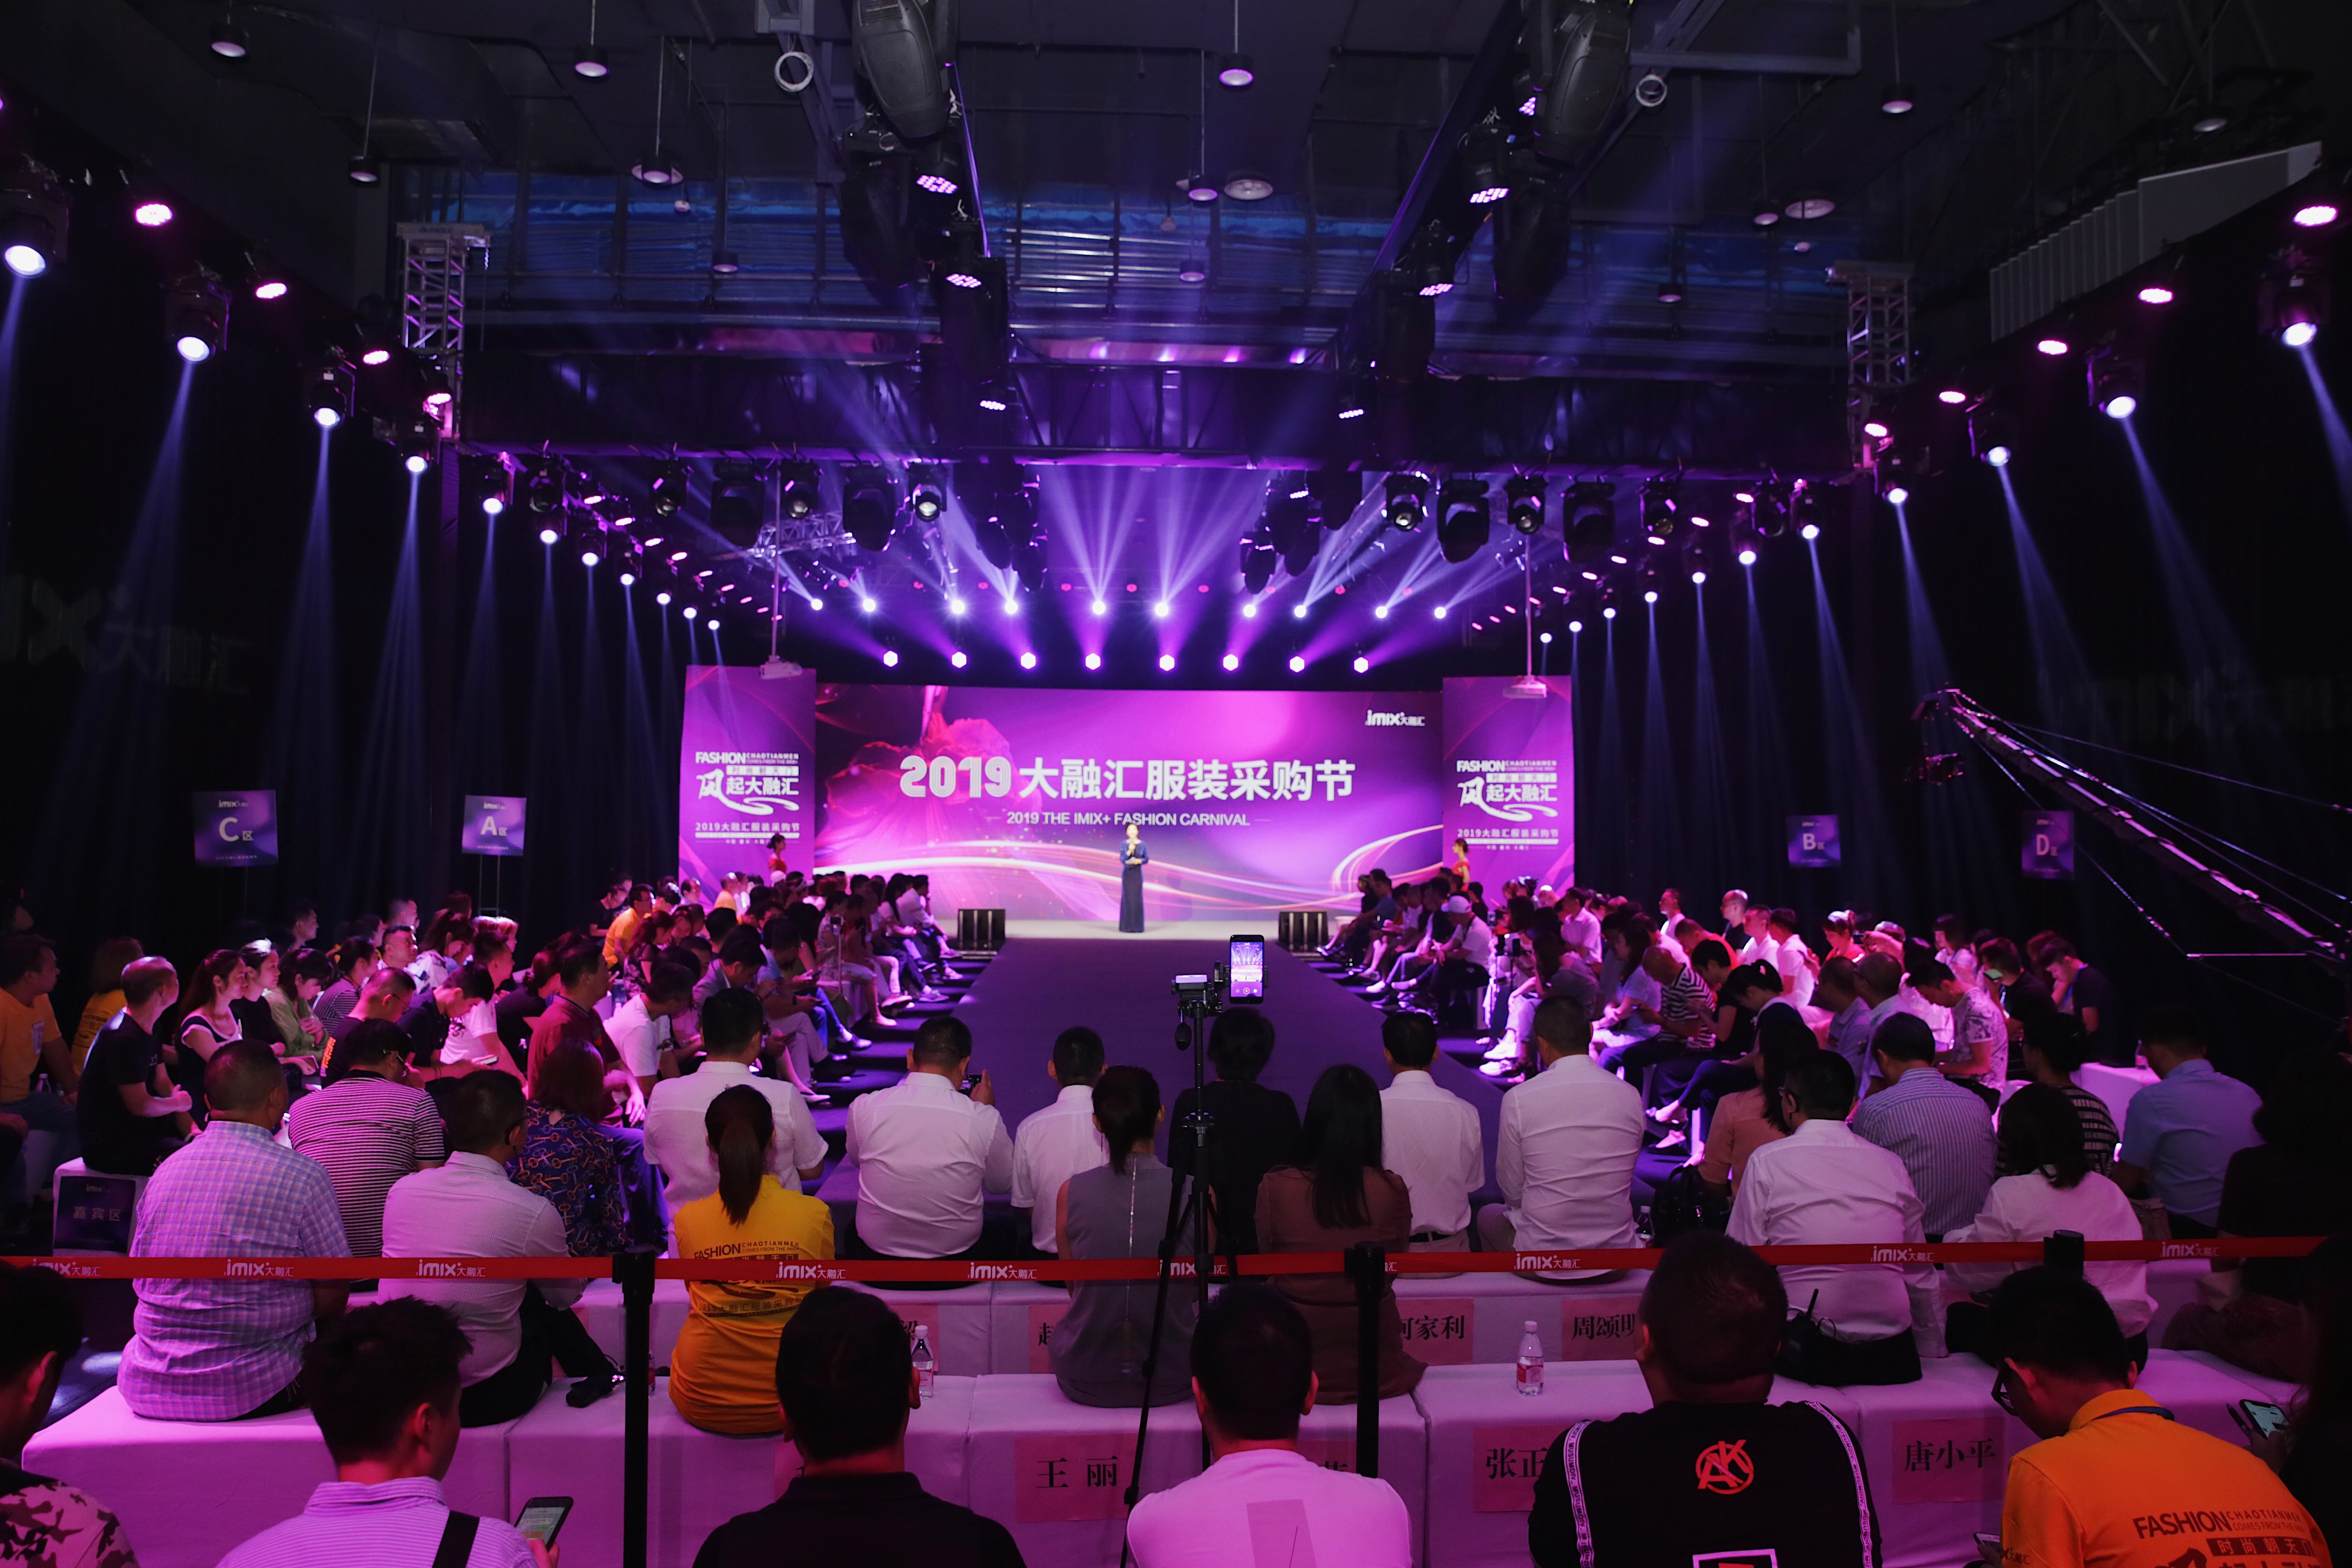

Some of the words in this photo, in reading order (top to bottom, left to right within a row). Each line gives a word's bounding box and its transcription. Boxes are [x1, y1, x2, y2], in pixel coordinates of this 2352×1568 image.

[695, 752, 746, 764] FASHION
[1457, 760, 1505, 772] FASHION
[1007, 812, 1039, 824] 2019
[1042, 812, 1070, 824] THE
[1074, 813, 1111, 825] IMIX+
[1114, 813, 1176, 825] FASHION
[1179, 813, 1250, 826] CARNIVAL
[694, 1243, 741, 1259] FASHION
[1904, 1438, 1996, 1472] 唐小平
[2133, 1511, 2232, 1539] FASHION
[2226, 1510, 2301, 1523] CHAOTIANMEN
[2232, 1522, 2261, 1530] COMES
[2217, 1538, 2314, 1556] 时尚朝天门
